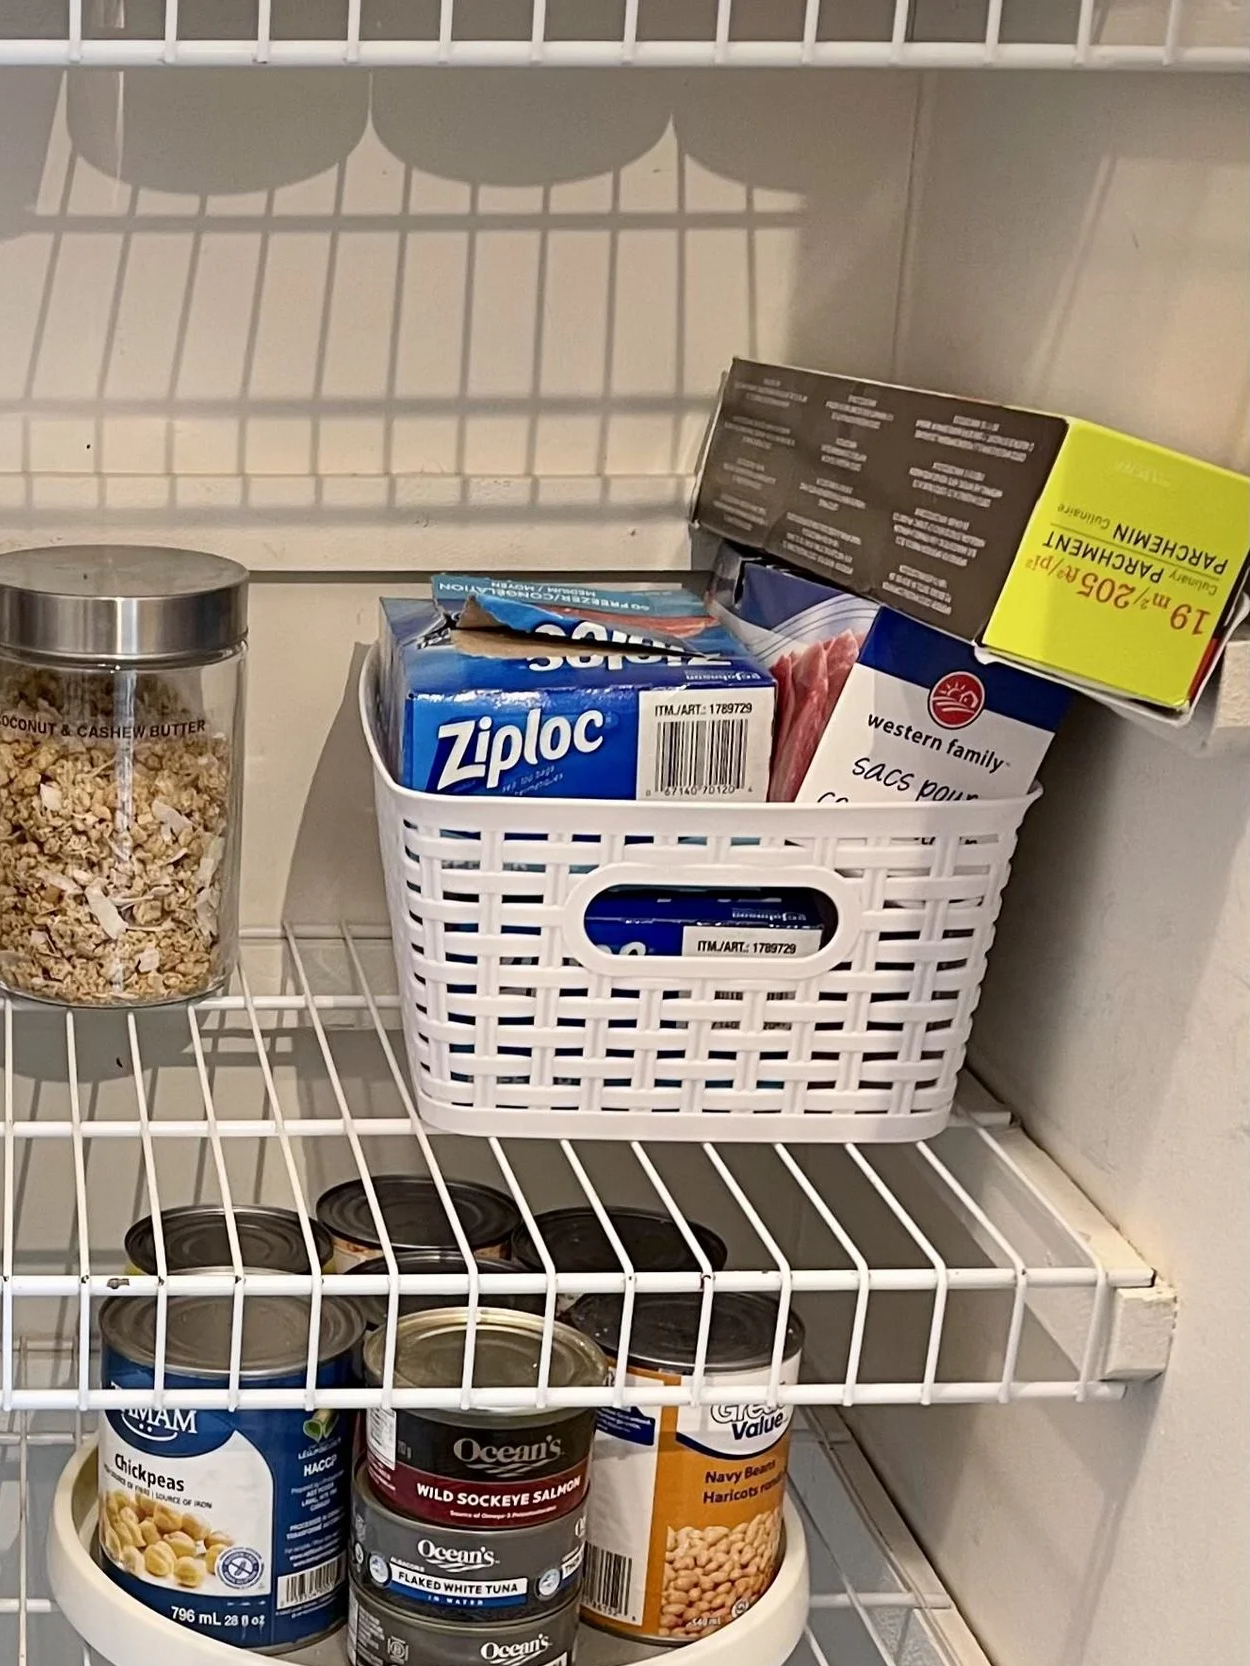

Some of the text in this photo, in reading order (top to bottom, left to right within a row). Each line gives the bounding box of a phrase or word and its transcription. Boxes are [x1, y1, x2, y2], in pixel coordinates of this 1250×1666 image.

[1113, 523, 1229, 575] PARCHEMIN
[1042, 530, 1218, 597] Culinary PARCHMENT
[1168, 603, 1212, 636] 19
[709, 702, 753, 715] 1789729
[60, 725, 71, 737] &
[77, 725, 146, 739] CASHEW
[150, 719, 206, 737] BUTTER
[437, 708, 604, 789] Ziploc
[867, 713, 1004, 774] western family
[851, 757, 914, 791] sacs
[752, 942, 797, 955] 1789729
[732, 1411, 784, 1441] Value
[453, 1435, 562, 1463] Ocean's
[114, 1453, 185, 1492] Chickpeas
[303, 1454, 338, 1478] HACCP
[705, 1470, 742, 1485] Navy
[416, 1475, 581, 1508] WILD SOCKEYE SALMON
[703, 1485, 759, 1505] Haricots
[417, 1538, 495, 1567] Ocean's
[398, 1571, 518, 1595] FLAKED WHITE TUNA
[171, 1606, 196, 1622] 796
[199, 1612, 222, 1626] mL
[224, 1615, 239, 1626] 28
[480, 1633, 550, 1660] Ocean's
